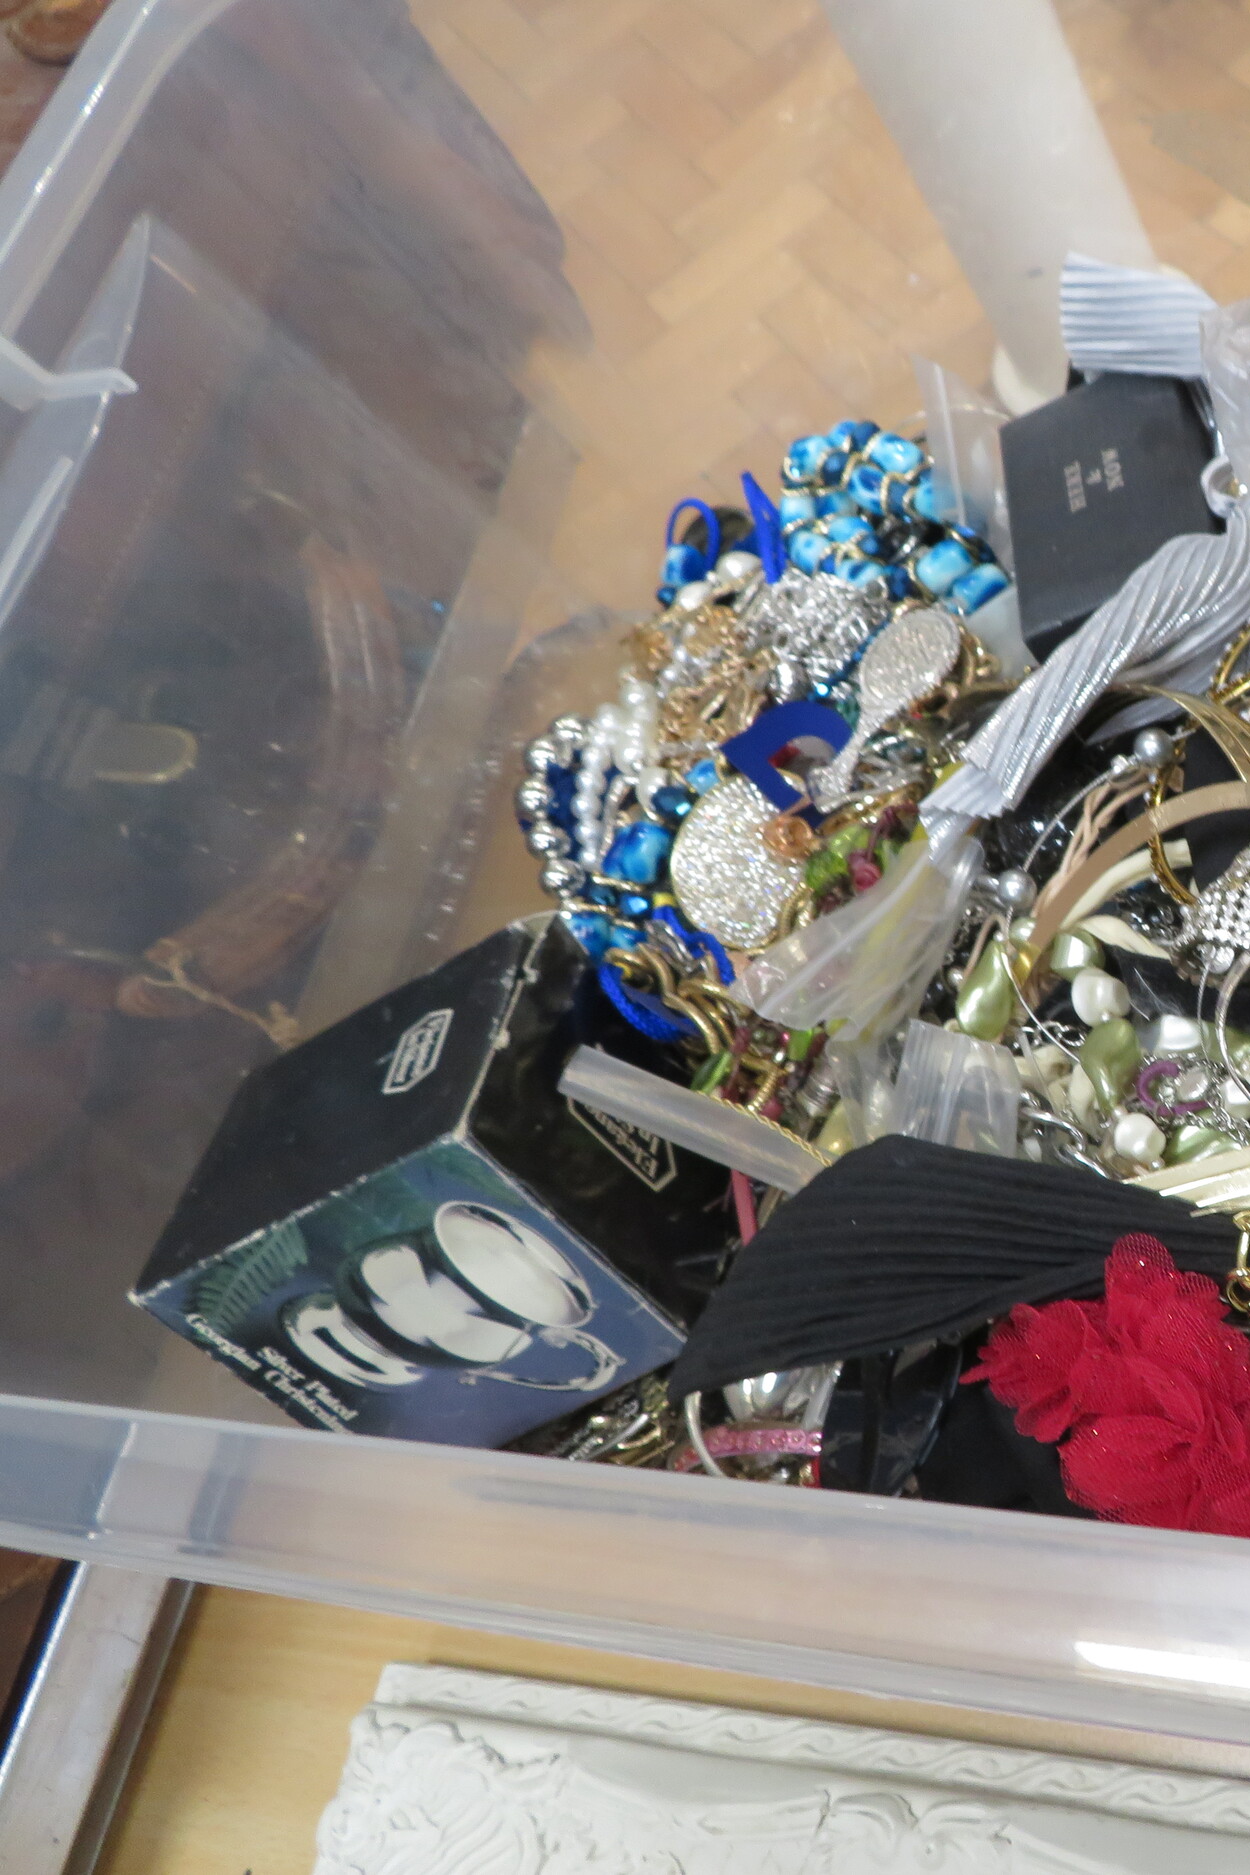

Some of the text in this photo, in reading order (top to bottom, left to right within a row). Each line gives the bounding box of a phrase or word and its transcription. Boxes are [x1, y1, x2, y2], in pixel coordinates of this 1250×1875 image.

[186, 1312, 262, 1371] Georgian
[256, 1346, 359, 1421] Silver Plated
